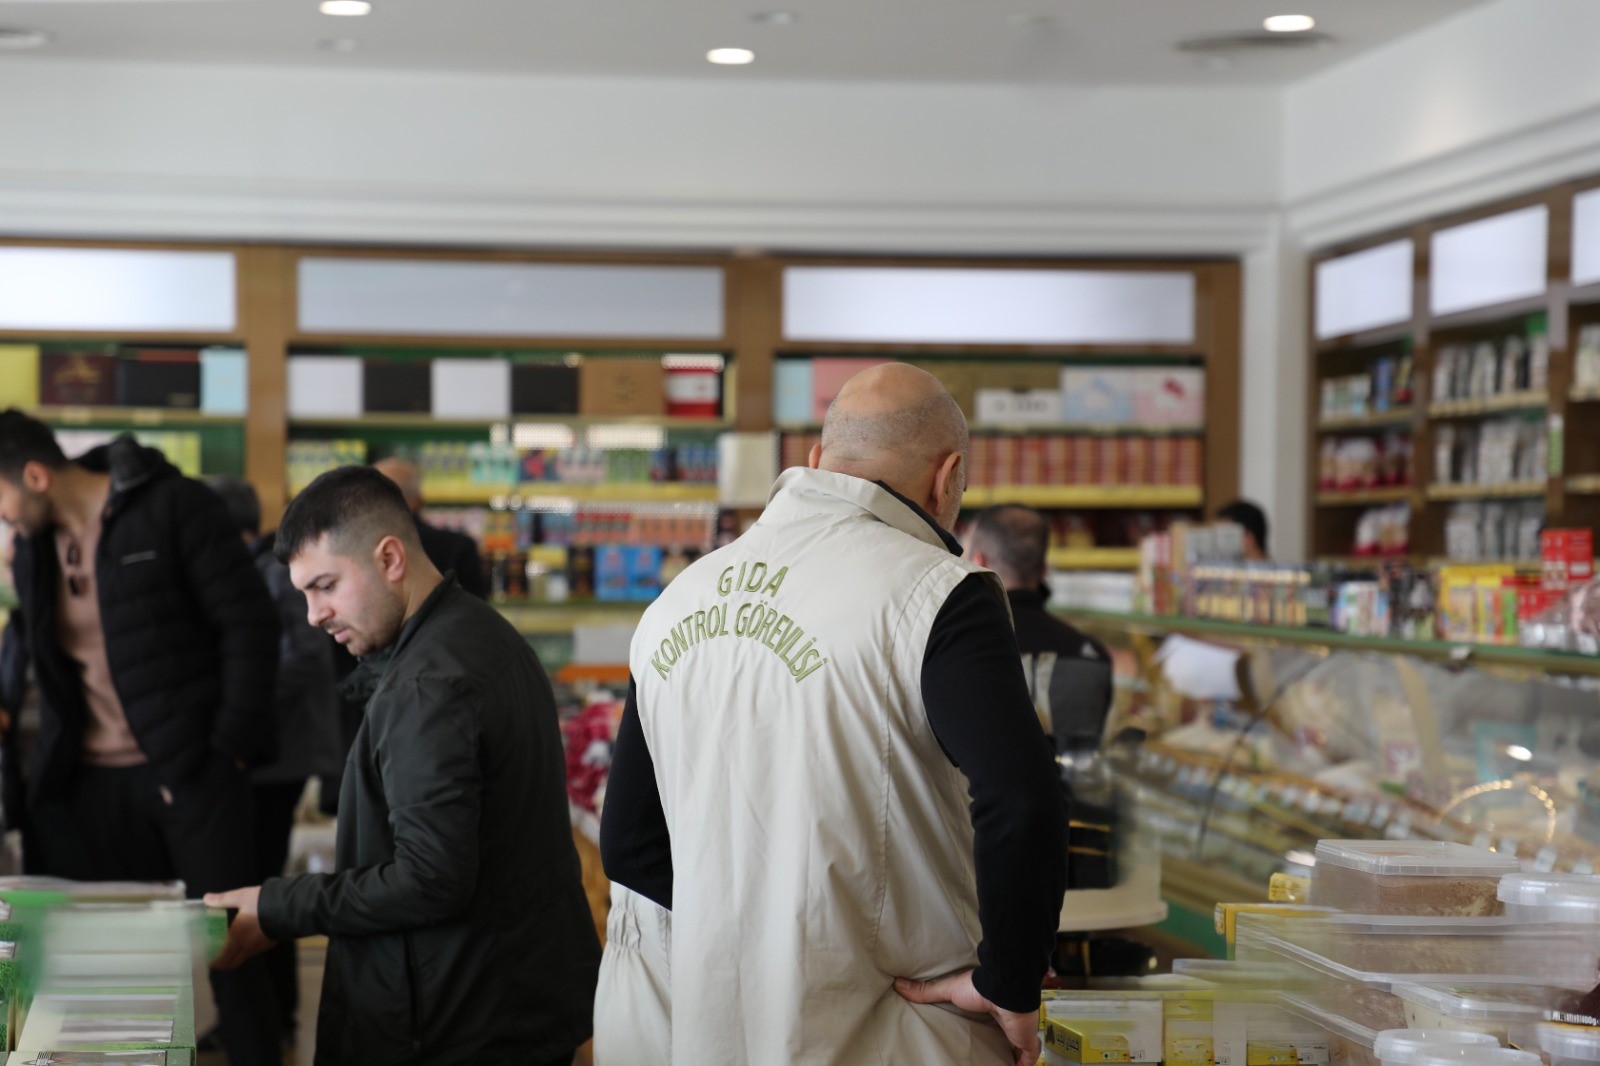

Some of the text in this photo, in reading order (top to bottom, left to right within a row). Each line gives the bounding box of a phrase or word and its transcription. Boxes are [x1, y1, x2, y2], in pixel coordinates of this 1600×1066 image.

[717, 561, 789, 597] GIDA
[651, 600, 828, 683] KONTROL GÖREVLİSİ
